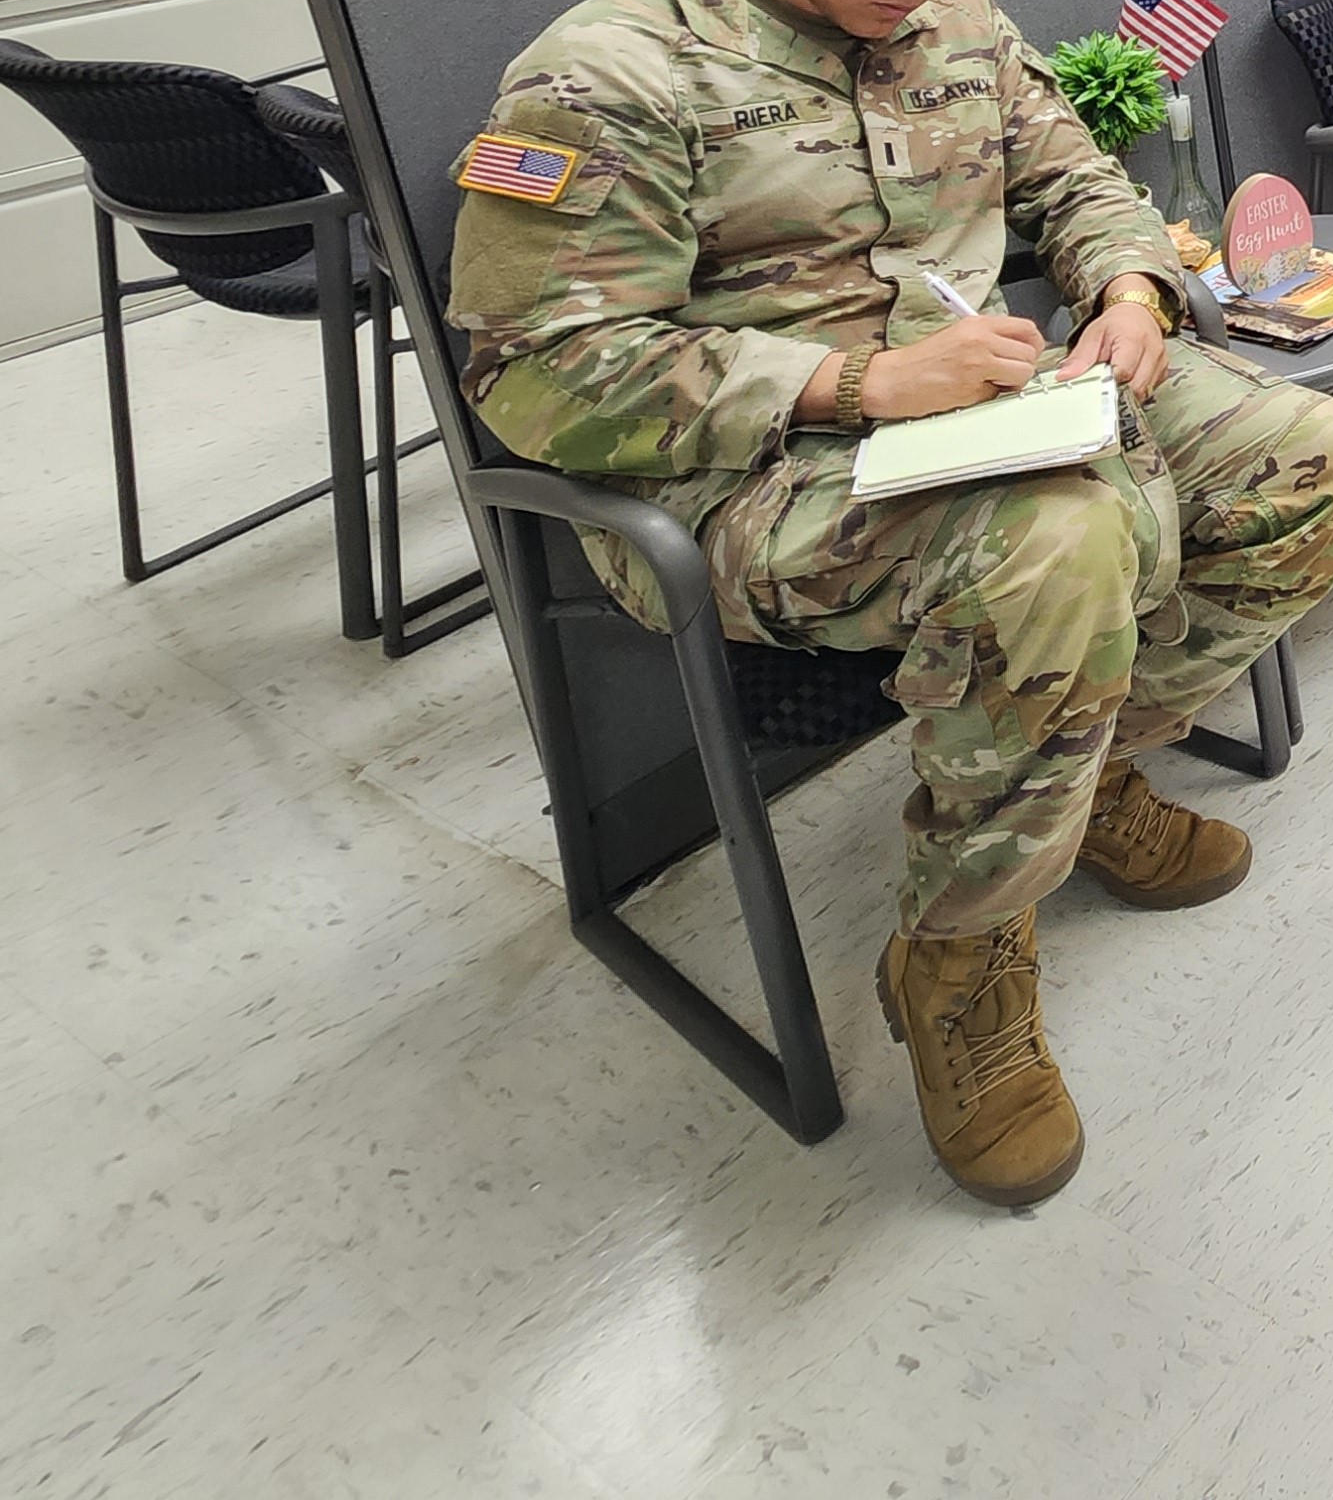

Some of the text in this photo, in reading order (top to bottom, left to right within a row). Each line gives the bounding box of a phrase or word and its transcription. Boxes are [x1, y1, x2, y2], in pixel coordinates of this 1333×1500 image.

[909, 77, 994, 109] U.S. ARMY
[732, 101, 799, 132] RIERA
[1246, 193, 1289, 226] EASTER
[1235, 213, 1305, 255] Egg Hunt
